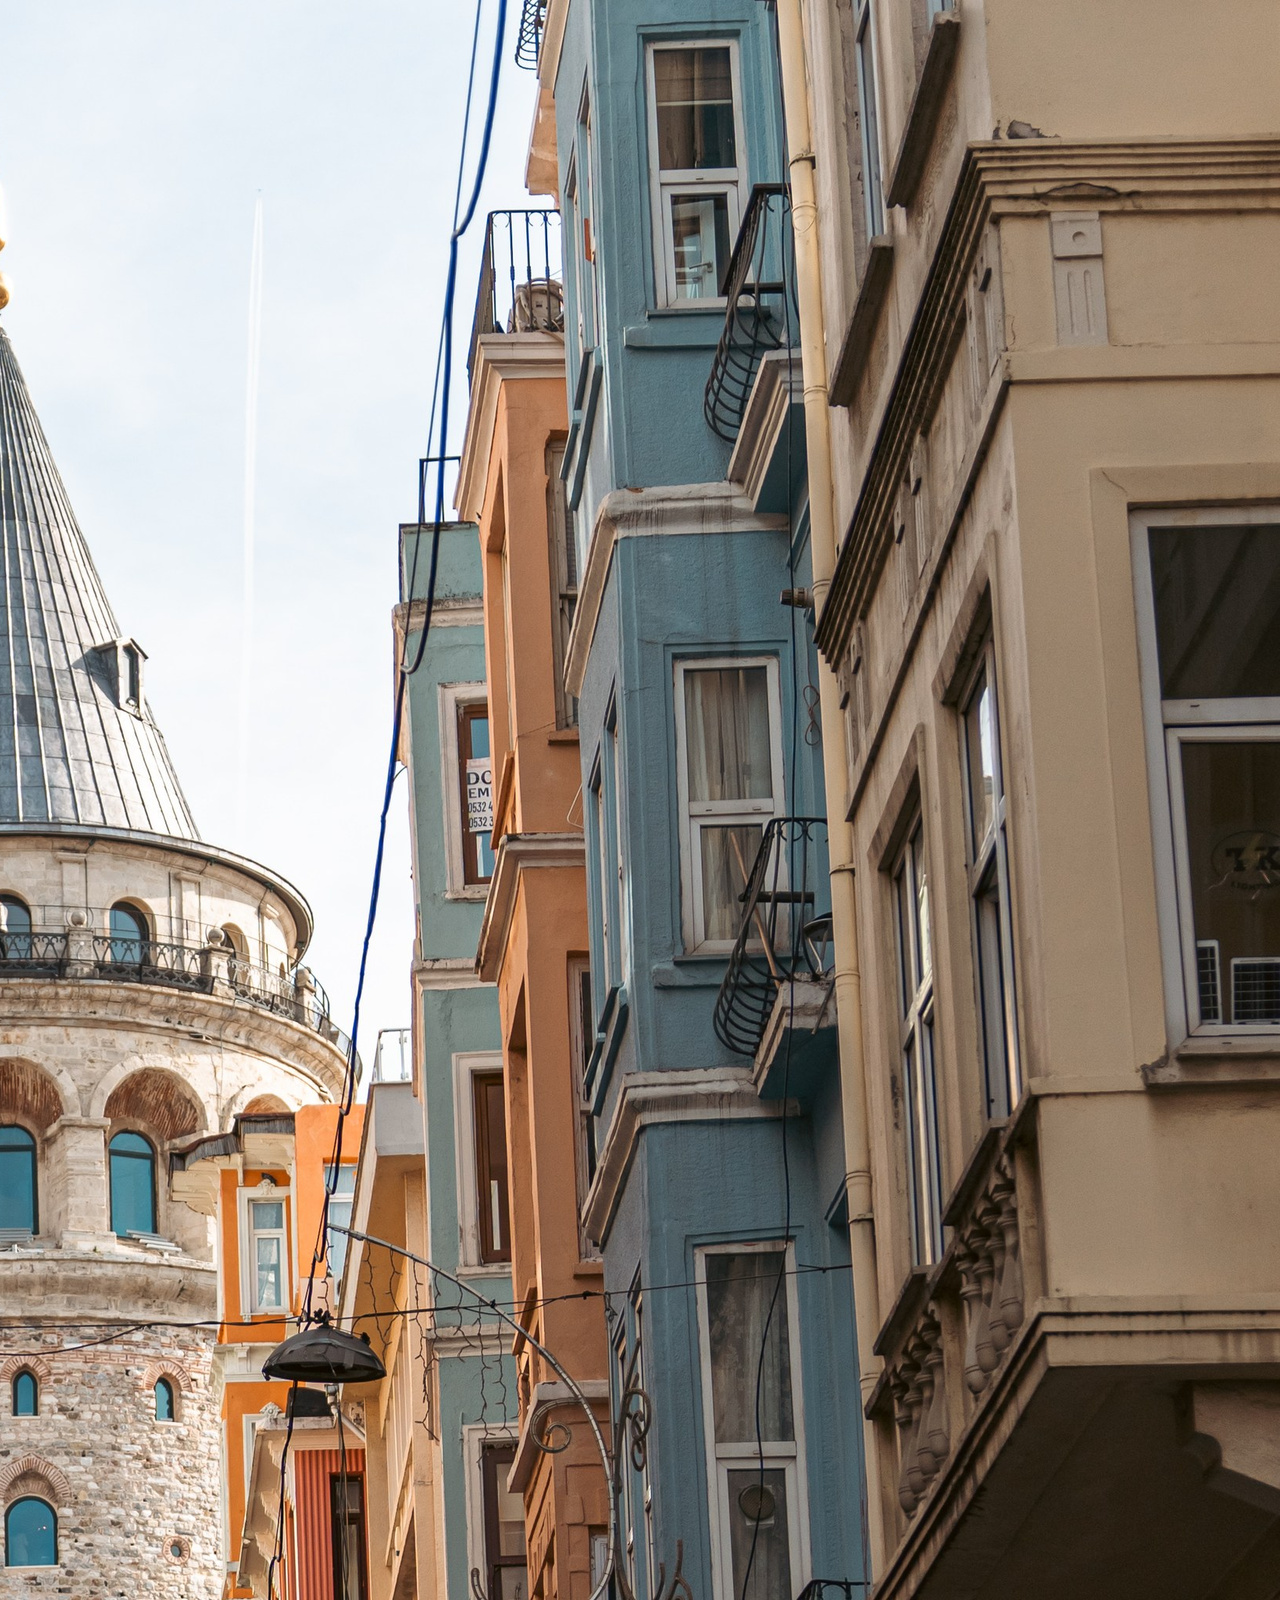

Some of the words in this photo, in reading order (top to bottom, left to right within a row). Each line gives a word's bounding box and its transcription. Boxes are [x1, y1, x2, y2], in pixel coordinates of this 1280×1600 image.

[467, 770, 491, 785] DO
[469, 787, 492, 798] EM
[468, 802, 486, 813] 0532
[469, 816, 487, 828] 0532
